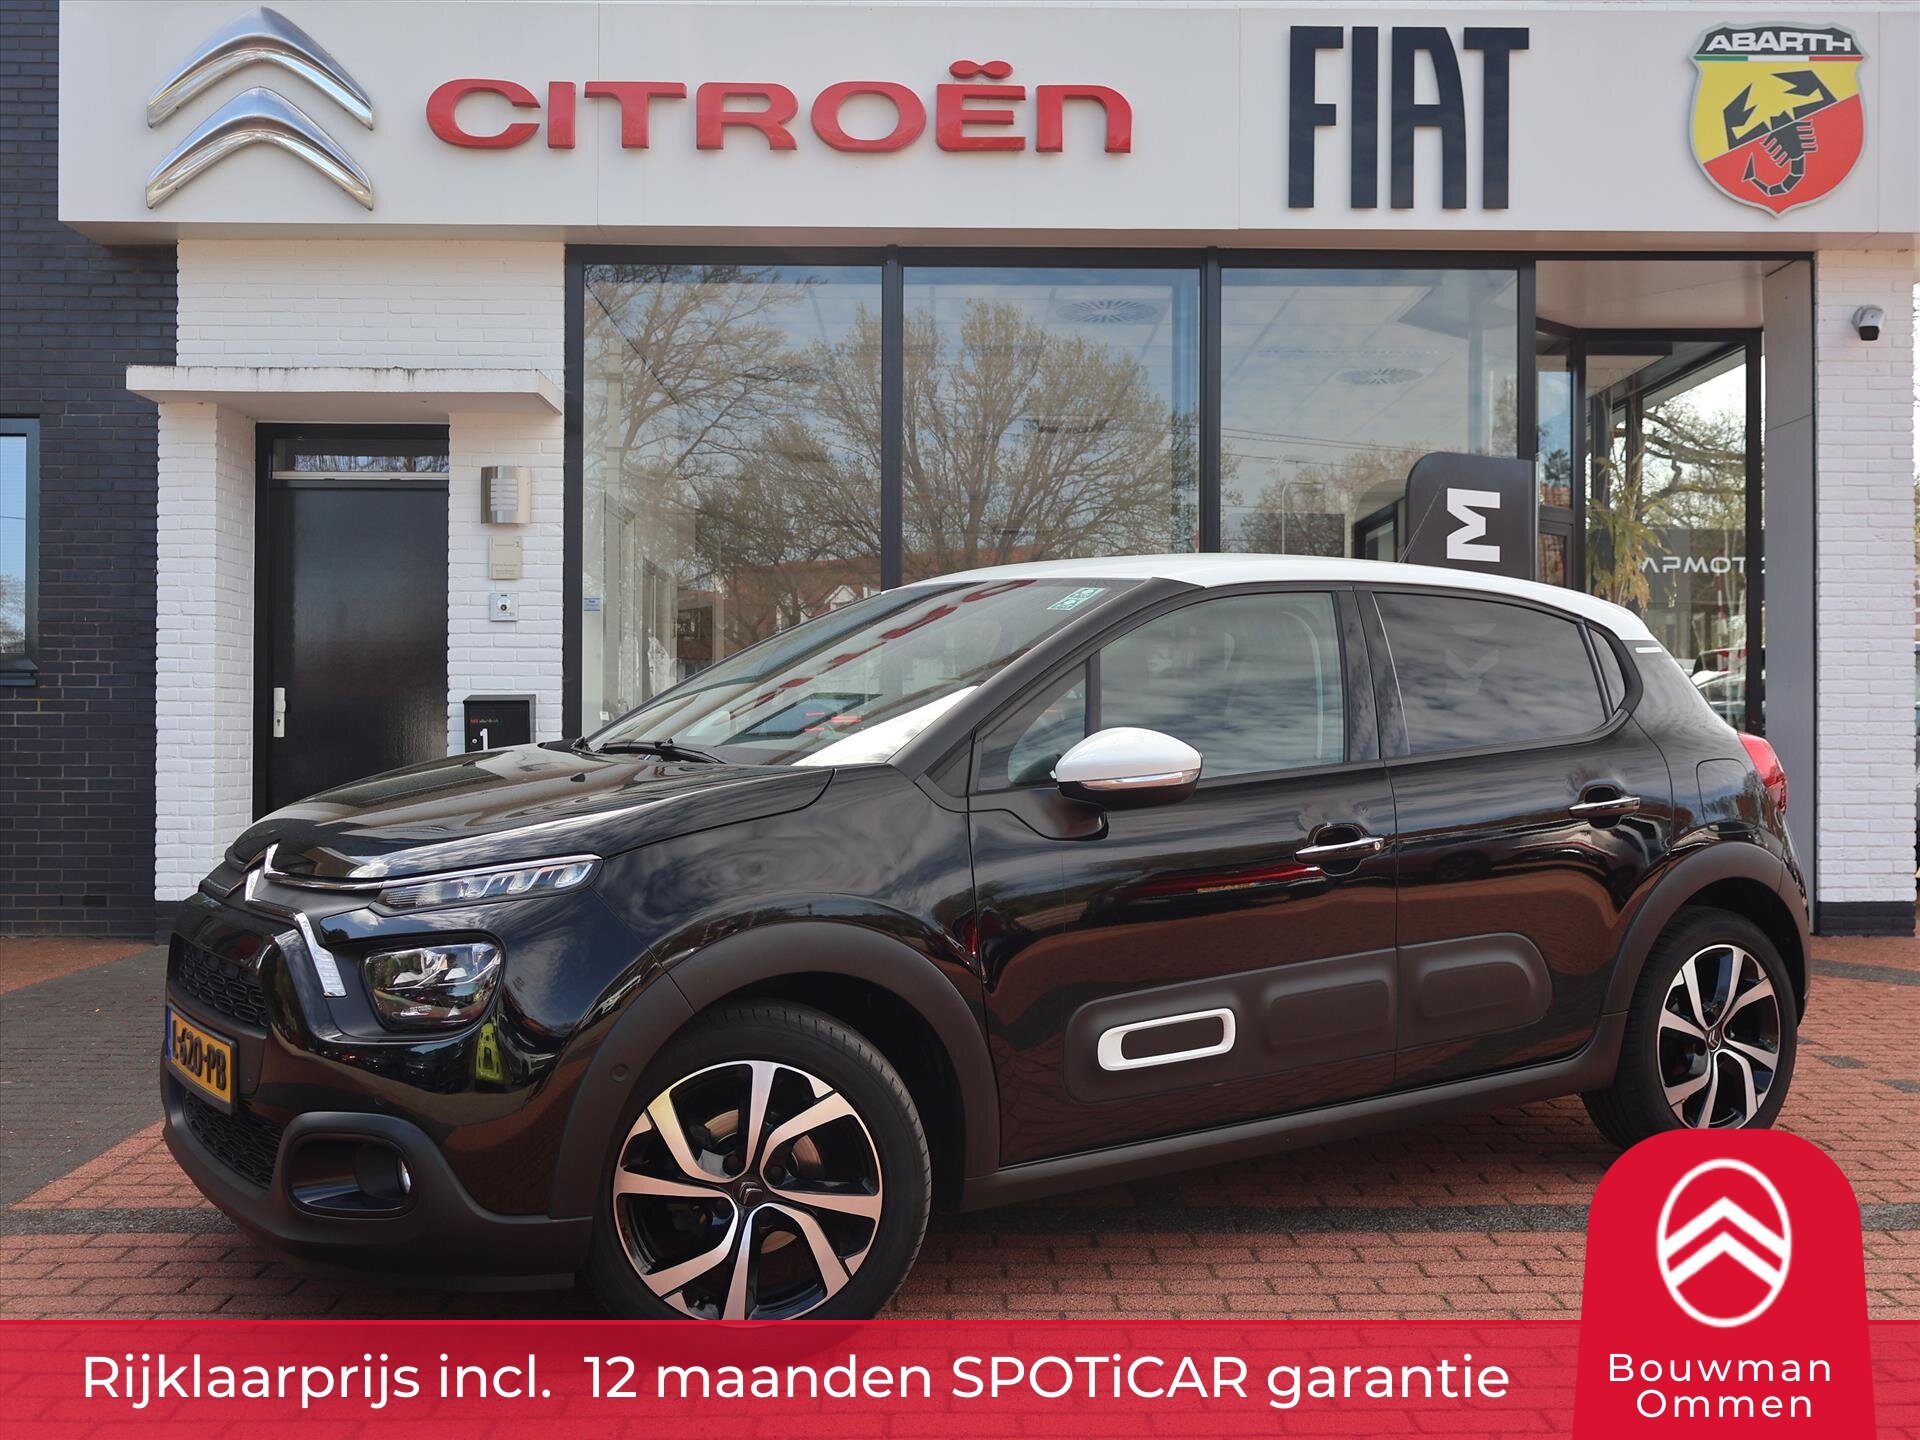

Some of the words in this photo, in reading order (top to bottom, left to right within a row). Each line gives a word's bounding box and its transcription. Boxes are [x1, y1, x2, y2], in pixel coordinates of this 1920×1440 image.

[1704, 31, 1851, 52] ABARTH
[427, 60, 1133, 153] CITROËN
[1288, 25, 1530, 210] FIAT
[1641, 556, 1765, 574] APMOT
